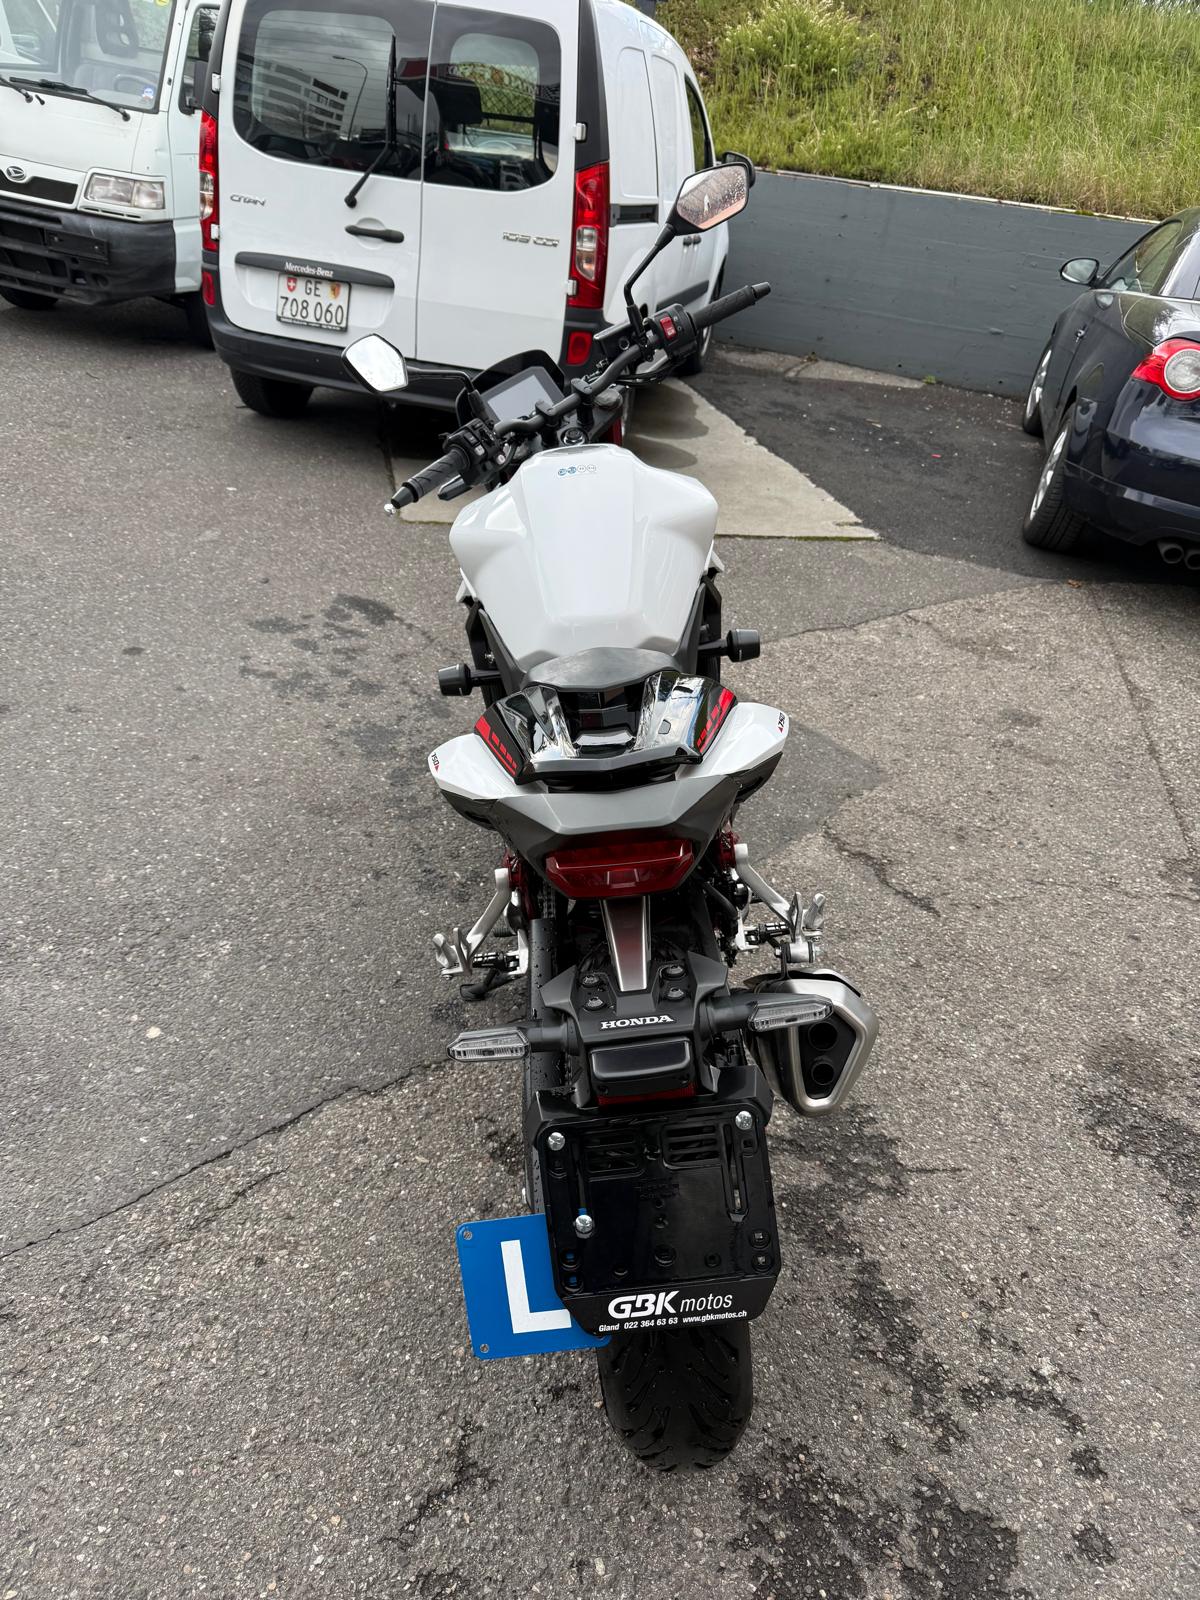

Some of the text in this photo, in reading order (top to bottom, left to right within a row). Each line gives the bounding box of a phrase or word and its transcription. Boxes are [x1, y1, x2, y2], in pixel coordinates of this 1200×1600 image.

[284, 261, 334, 278] Mercedes-Benz
[305, 279, 322, 297] GE
[280, 295, 309, 319] 708
[314, 302, 344, 325] 060
[600, 1015, 674, 1030] HONDA
[500, 1239, 572, 1334] L
[608, 1290, 733, 1319] GBK motos
[598, 1309, 747, 1332] Gland 022 364 63 63 www.gbkmotos.ch
